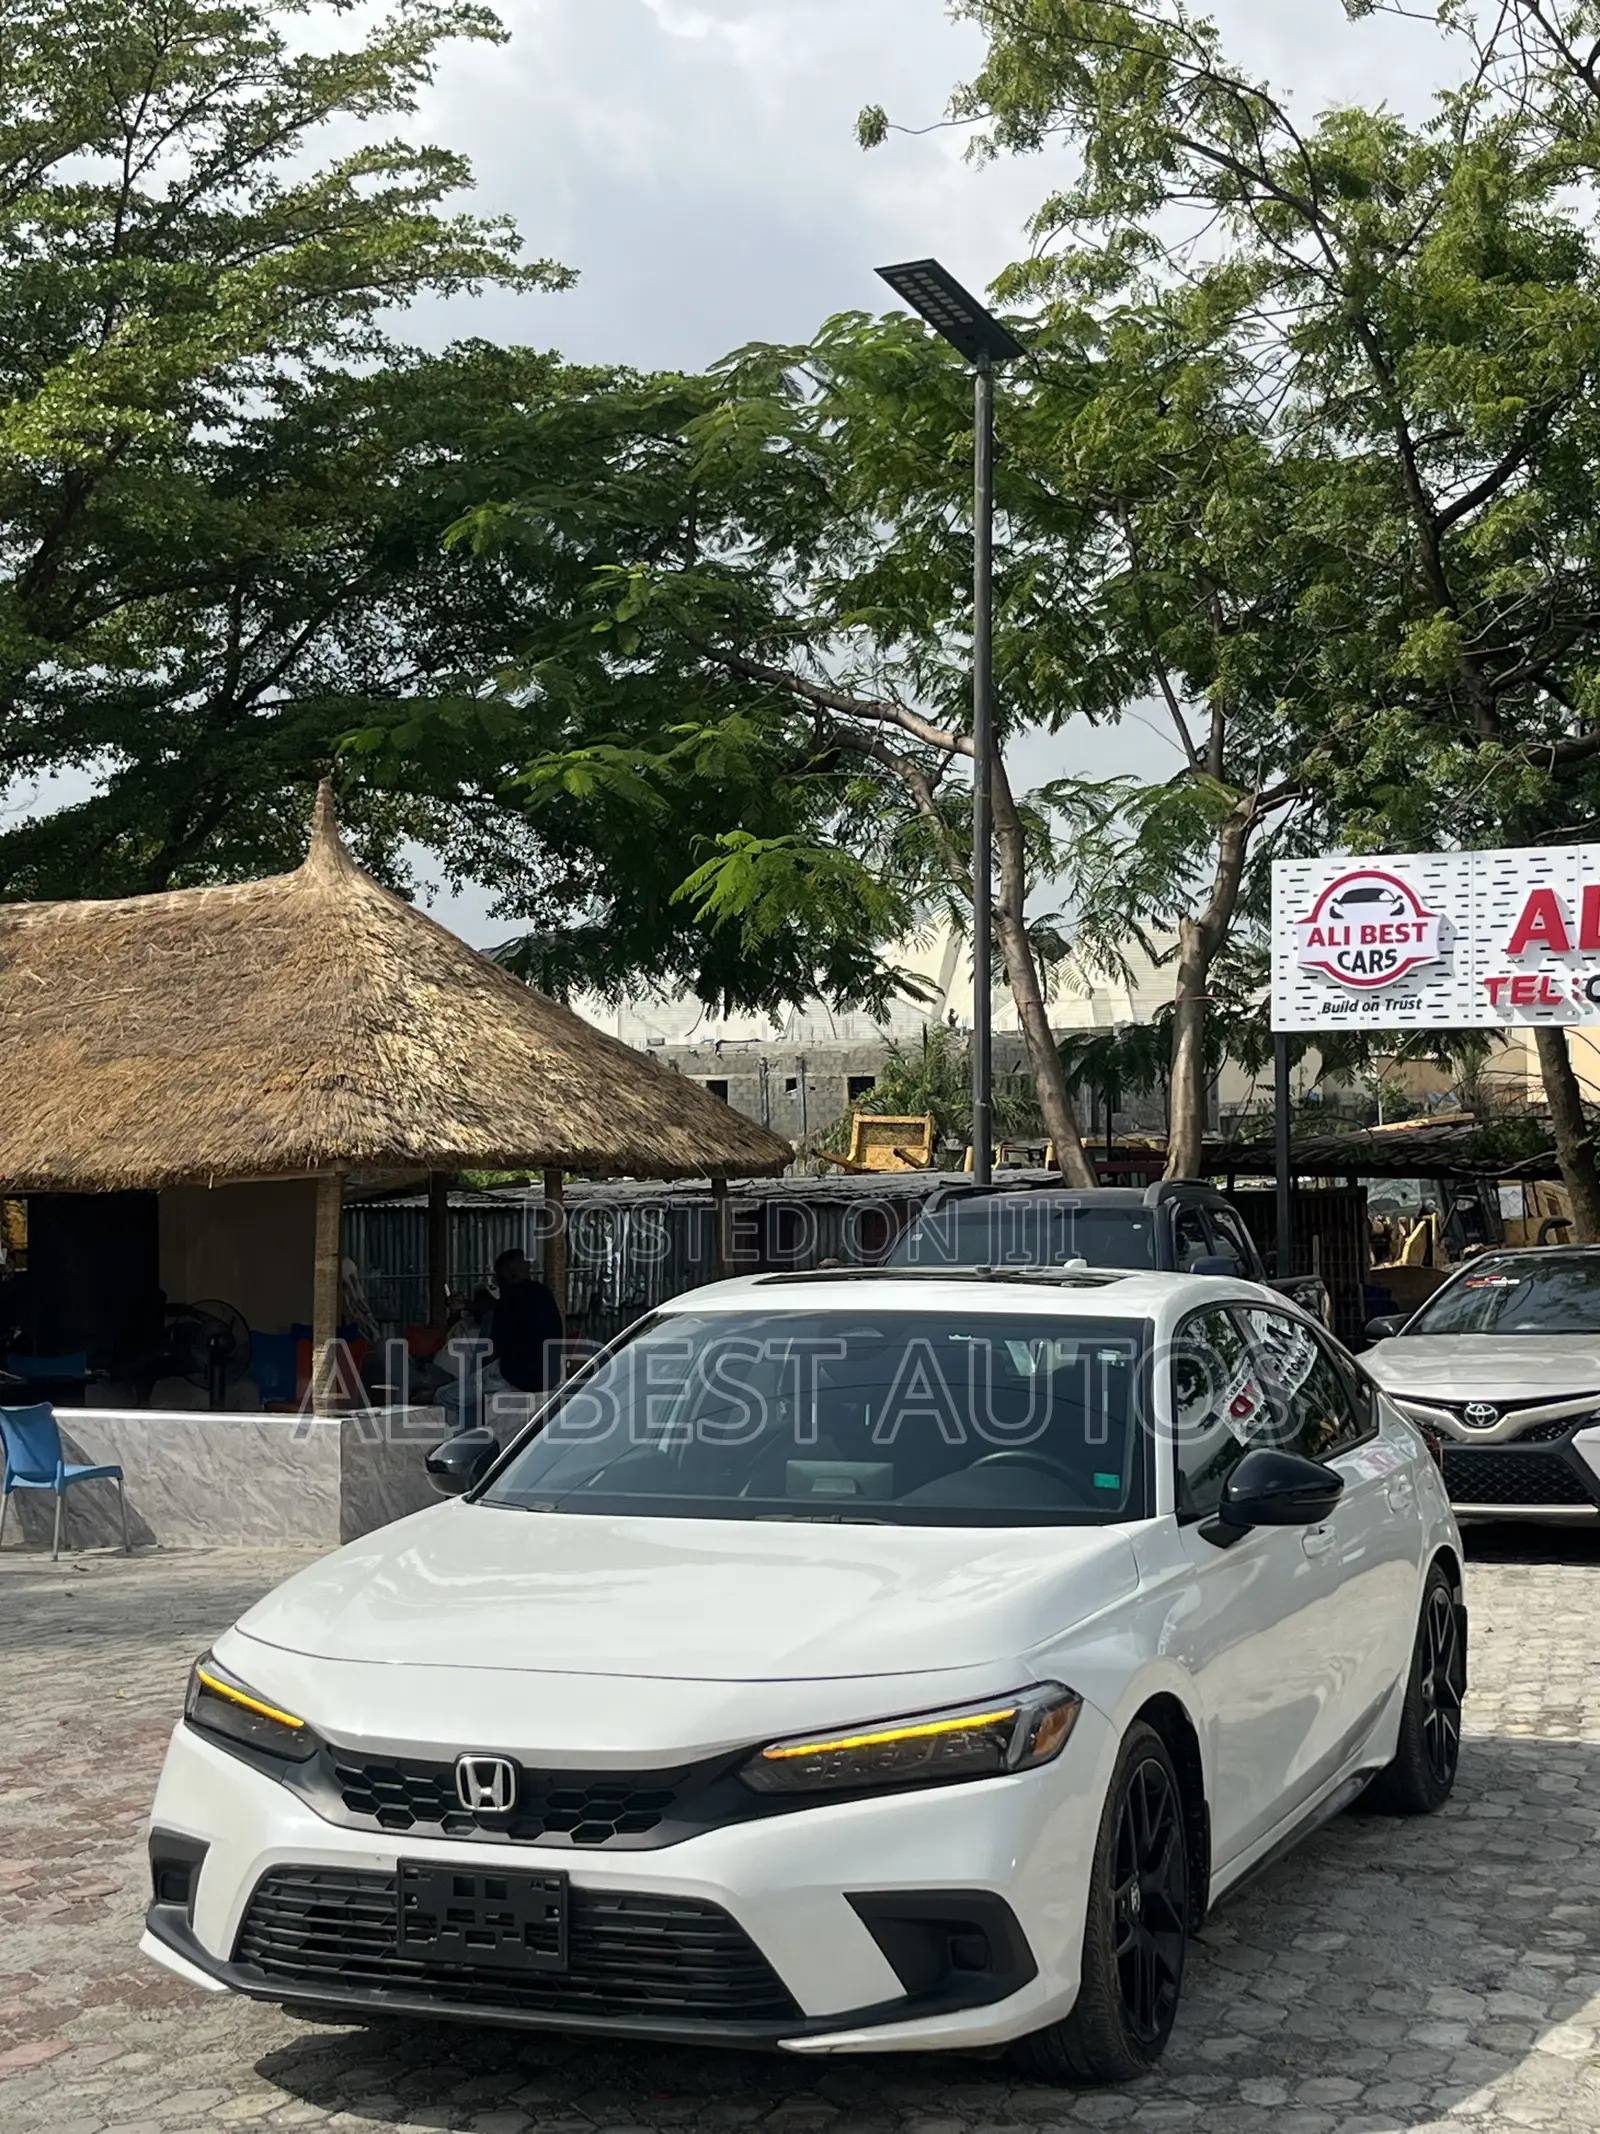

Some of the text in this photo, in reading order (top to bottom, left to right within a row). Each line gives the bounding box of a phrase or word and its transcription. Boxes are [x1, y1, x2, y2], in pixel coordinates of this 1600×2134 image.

[1307, 922, 1428, 947] ALI BEST
[1337, 948, 1398, 974] CARS
[1321, 998, 1423, 1014] Build on Trust
